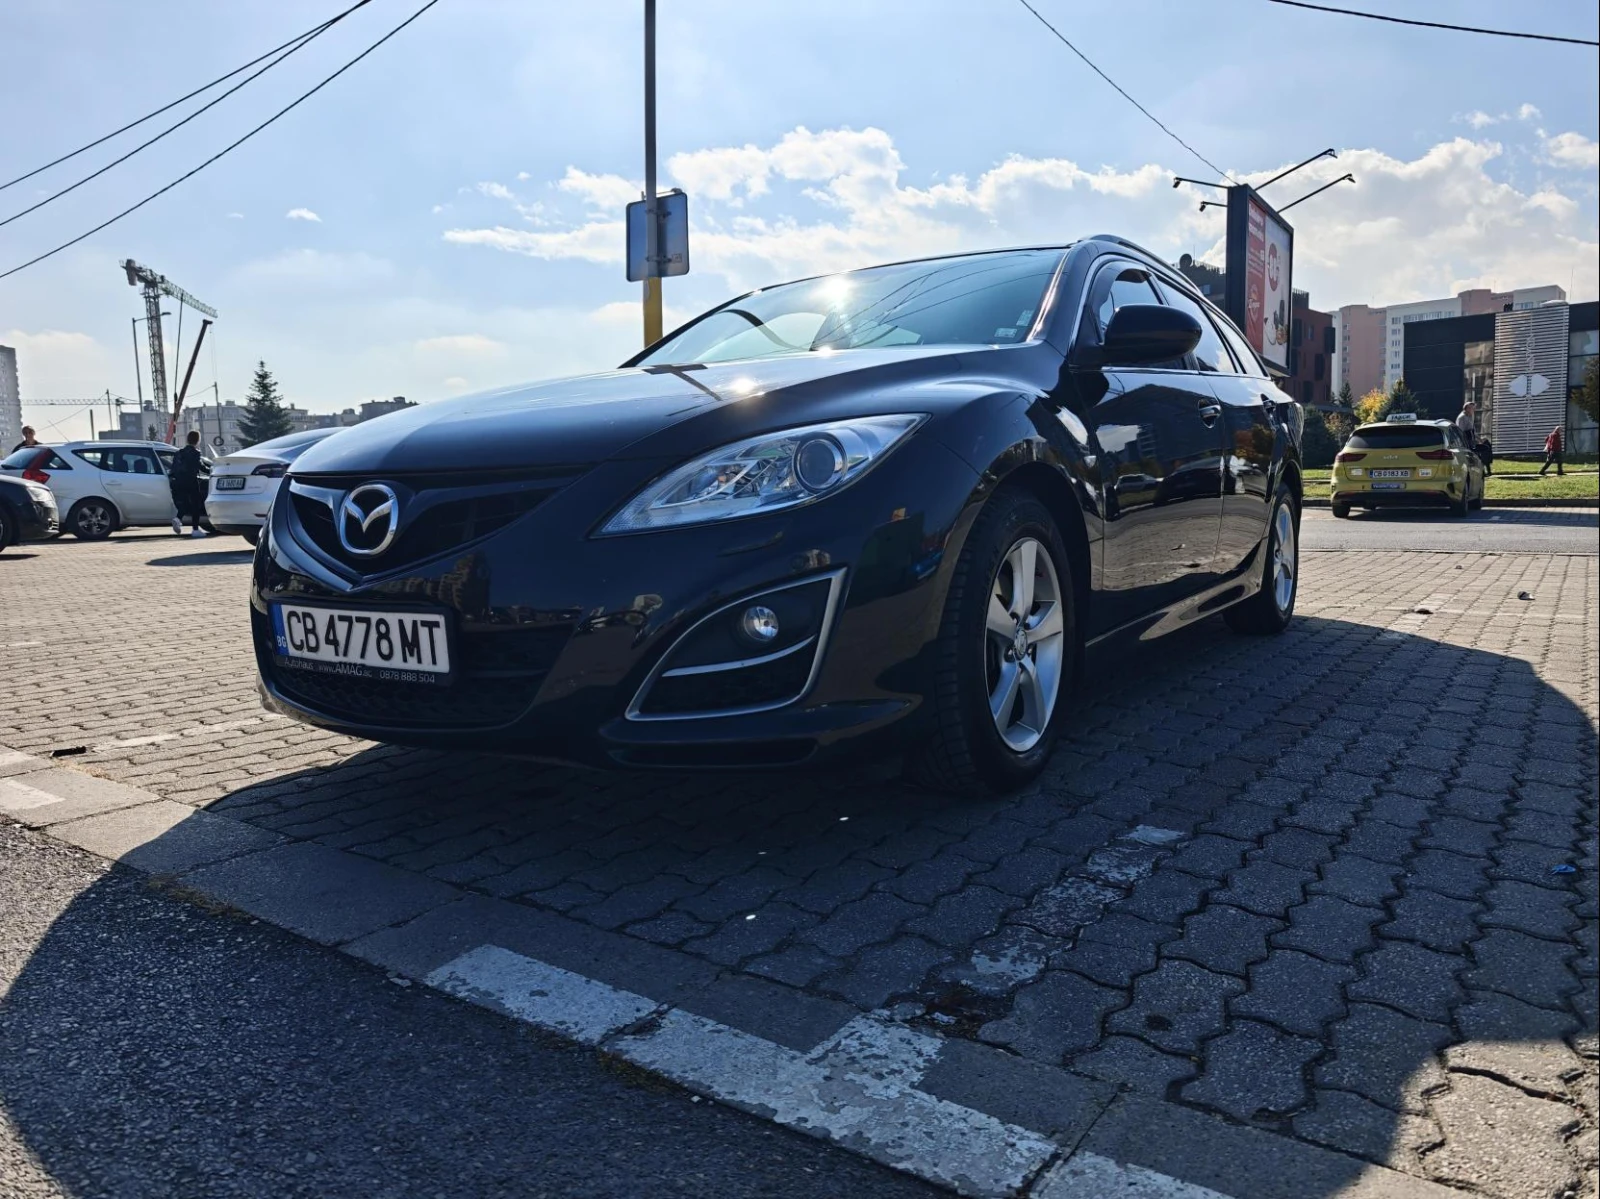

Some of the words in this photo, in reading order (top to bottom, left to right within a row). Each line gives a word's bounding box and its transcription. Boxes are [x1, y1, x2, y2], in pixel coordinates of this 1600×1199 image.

[277, 635, 287, 647] BG
[287, 610, 320, 652] CB
[324, 614, 394, 661] 4778
[398, 619, 441, 666] MT
[379, 670, 399, 681] 0878
[400, 672, 418, 682] 888
[418, 673, 435, 684] 504
